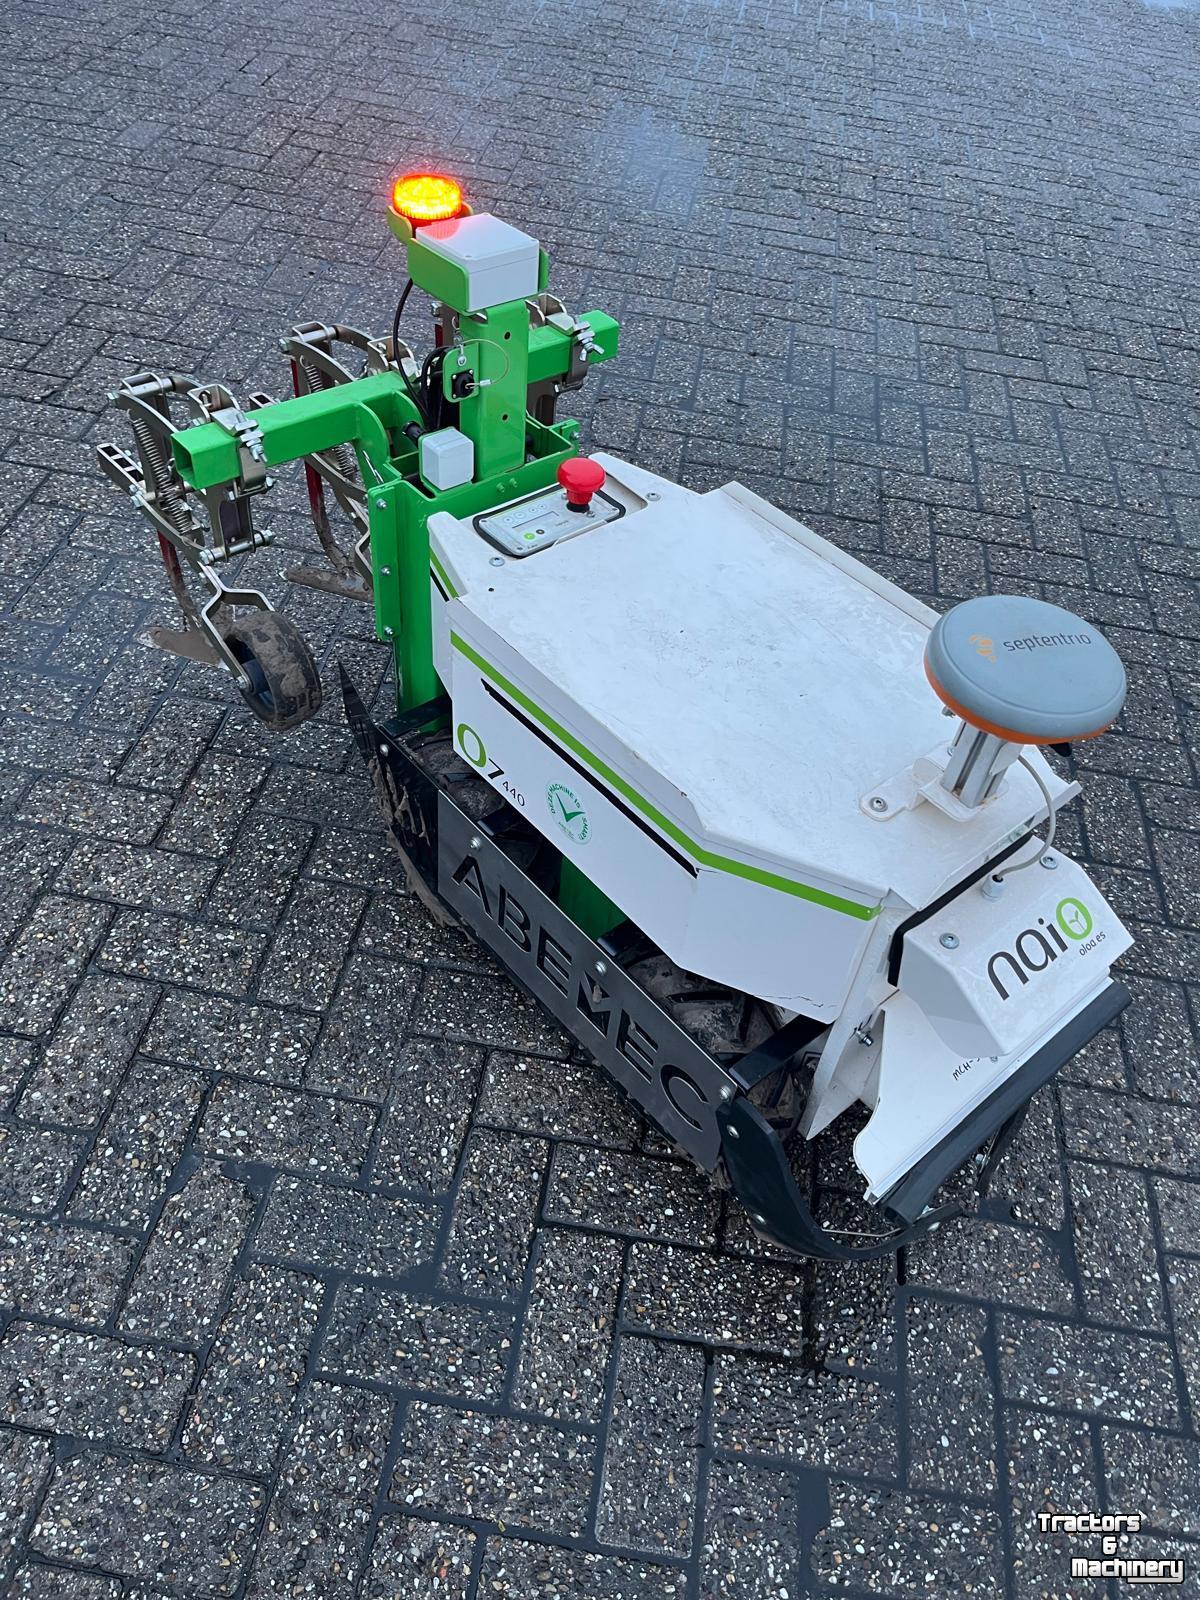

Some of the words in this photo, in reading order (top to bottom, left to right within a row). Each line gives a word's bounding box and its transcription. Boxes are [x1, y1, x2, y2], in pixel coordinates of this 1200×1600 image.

[1003, 632, 1092, 652] septentrio
[502, 780, 525, 807] 440
[450, 854, 710, 1133] ABEMEC
